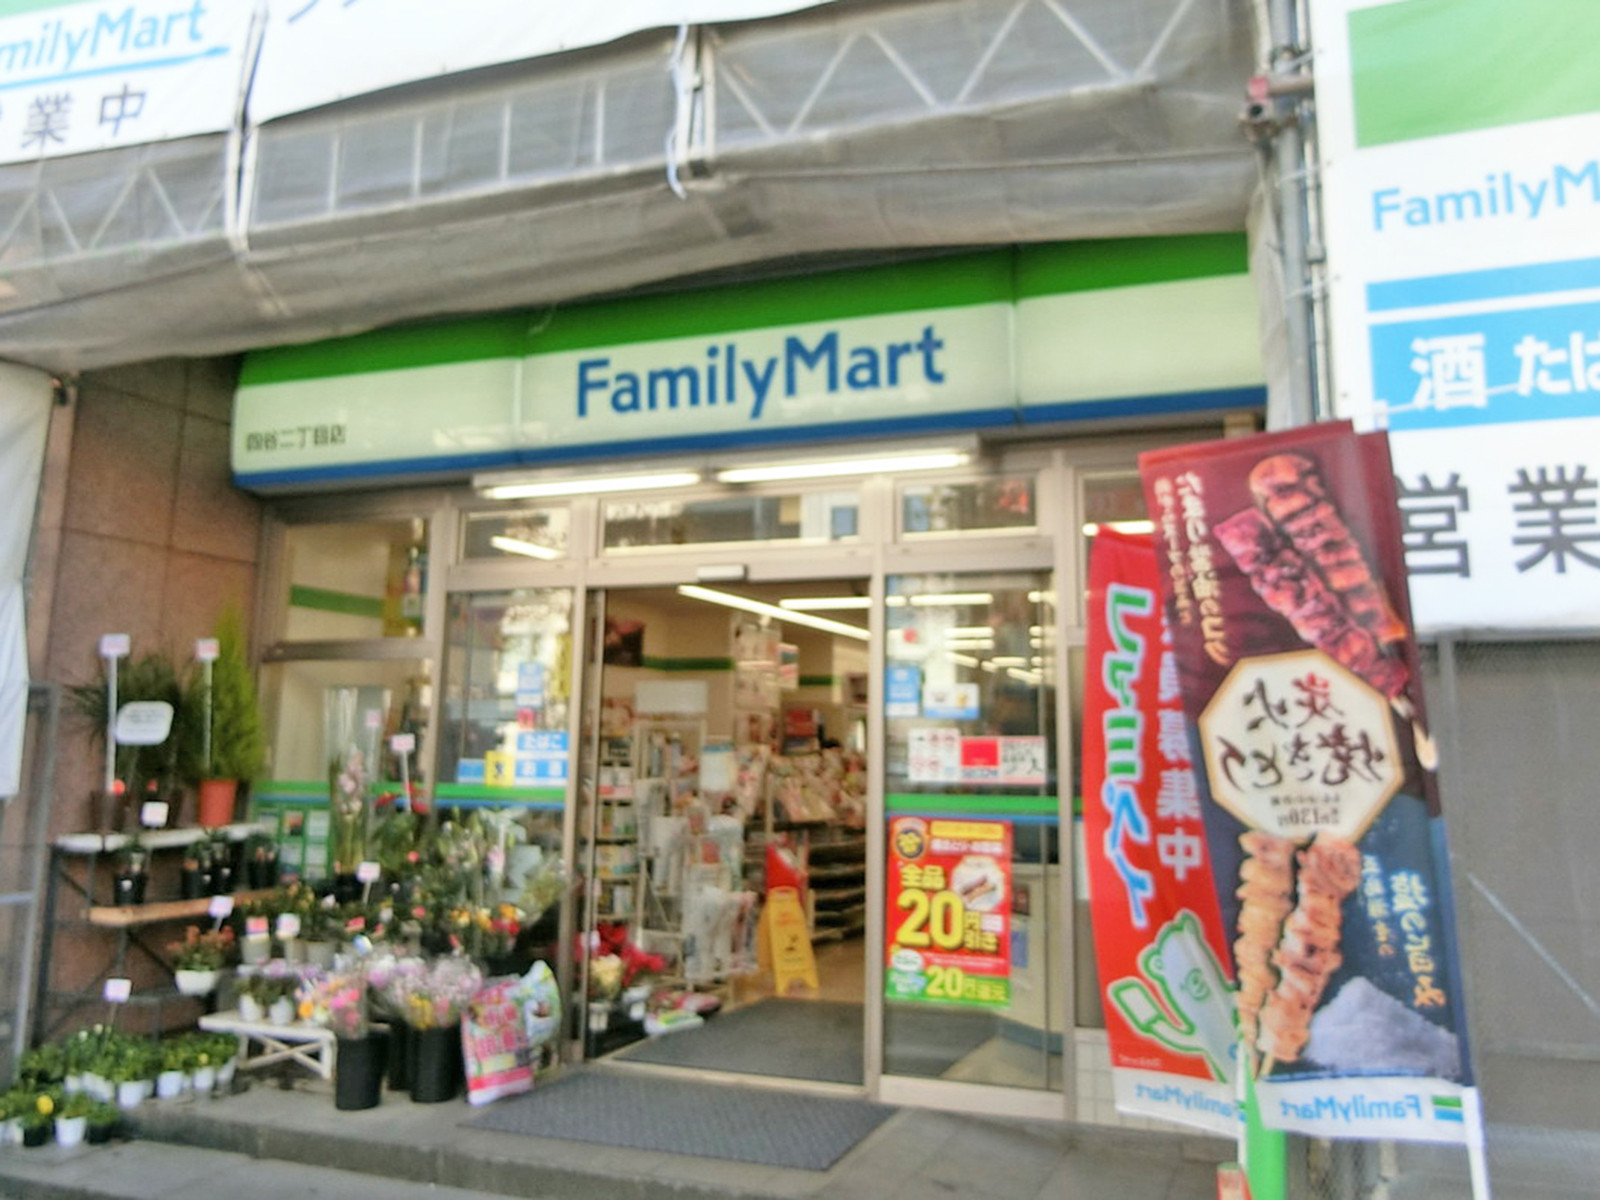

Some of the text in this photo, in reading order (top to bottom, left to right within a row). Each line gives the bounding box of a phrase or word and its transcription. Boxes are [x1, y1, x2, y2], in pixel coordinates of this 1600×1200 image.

[0, 83, 146, 148] 業中
[1372, 161, 1600, 231] FamilyM
[577, 325, 945, 419] FamilyMart
[1410, 333, 1488, 411] 酒
[900, 864, 945, 889] 全品
[896, 888, 964, 949] 20
[926, 965, 963, 998] 20
